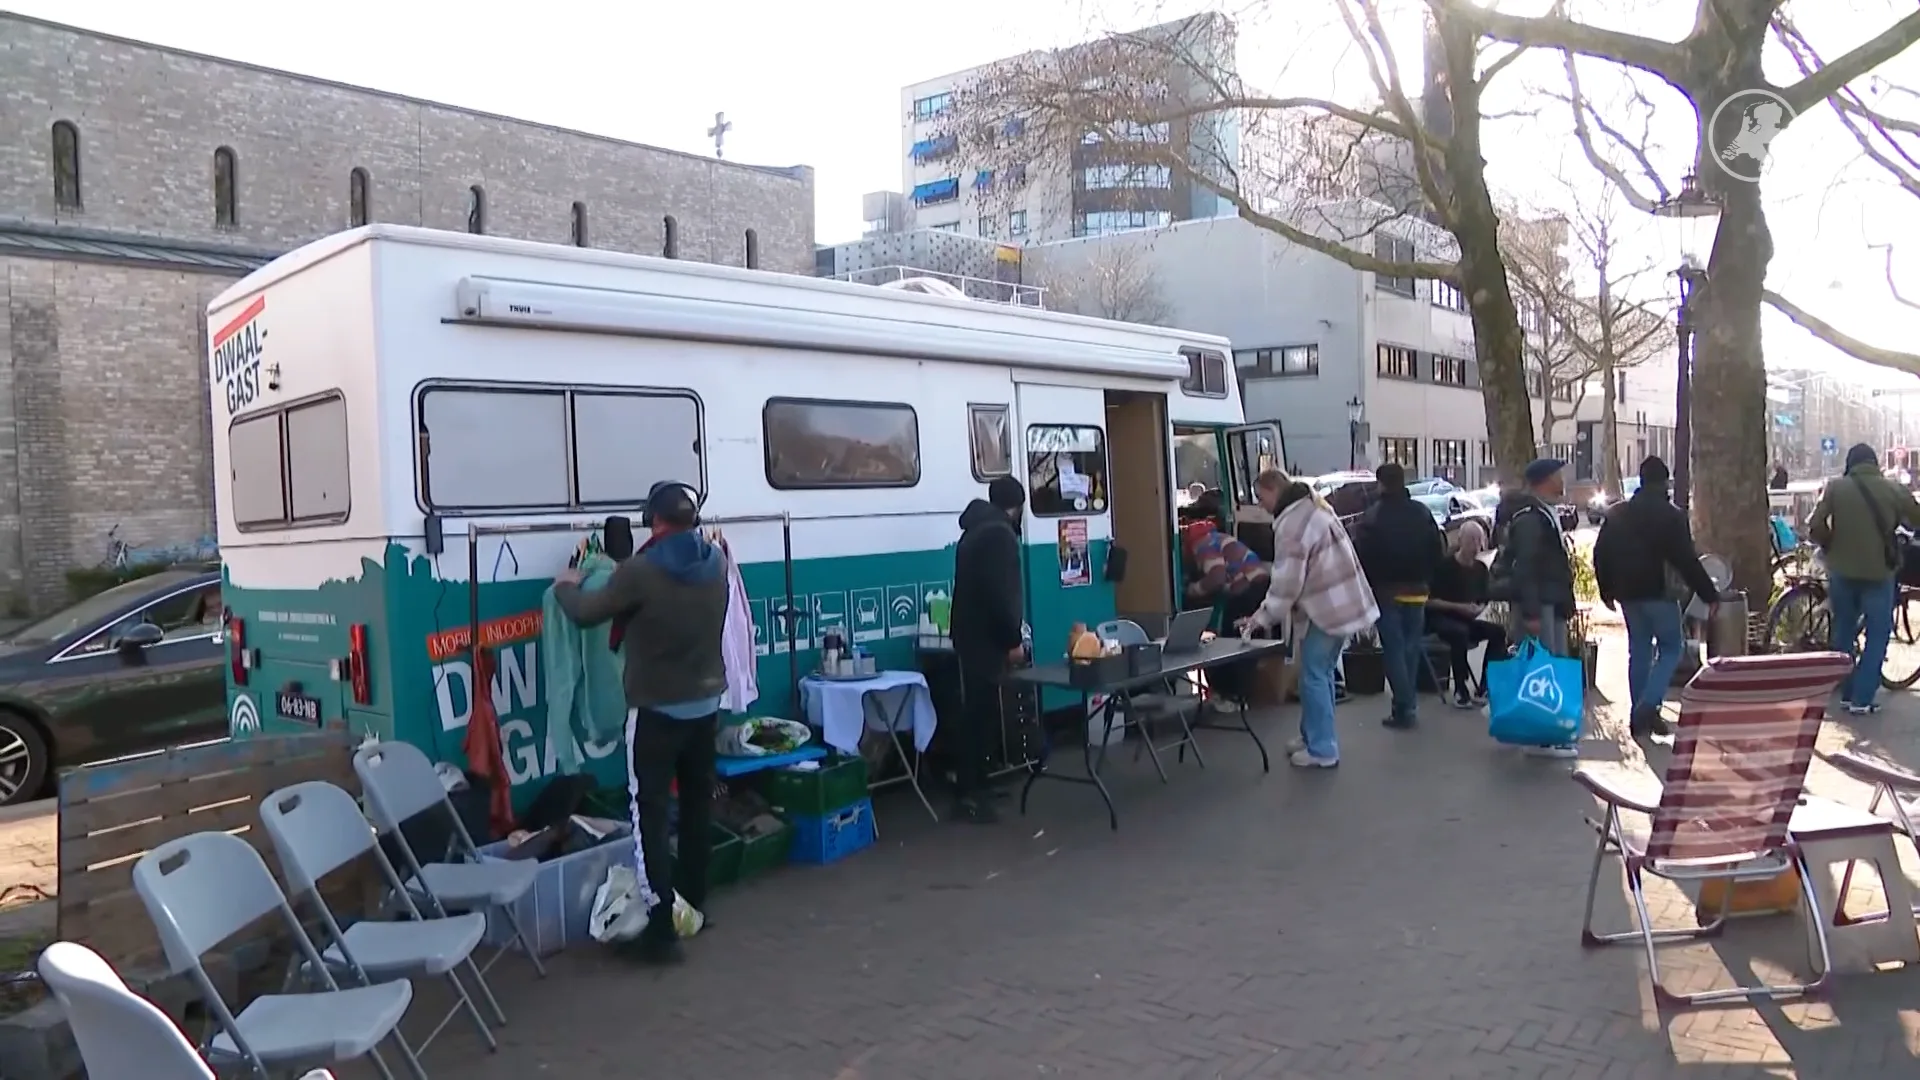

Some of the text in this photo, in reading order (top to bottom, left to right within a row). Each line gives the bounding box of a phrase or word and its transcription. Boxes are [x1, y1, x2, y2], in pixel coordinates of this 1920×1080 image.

[214, 319, 268, 383] DWAAL-
[226, 361, 261, 415] GAST
[281, 695, 317, 719] 06-83-NB
[432, 641, 536, 732] DW
